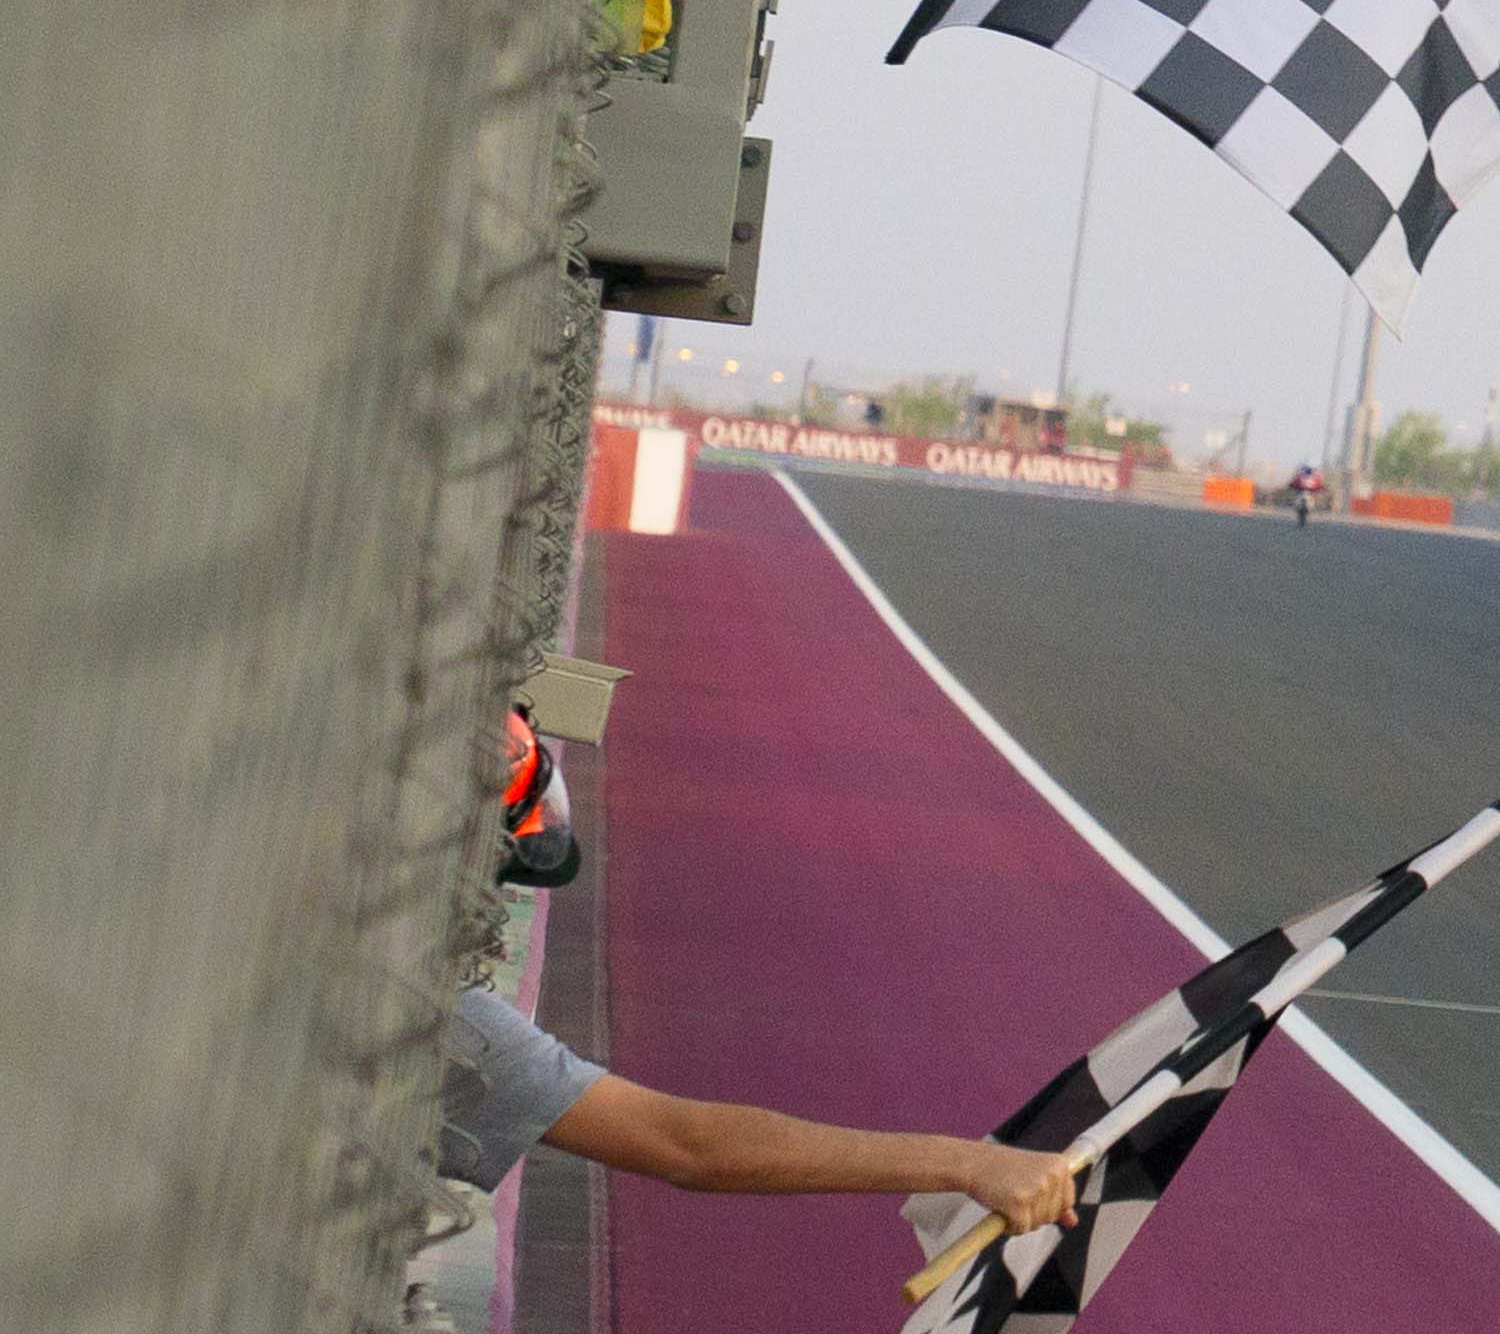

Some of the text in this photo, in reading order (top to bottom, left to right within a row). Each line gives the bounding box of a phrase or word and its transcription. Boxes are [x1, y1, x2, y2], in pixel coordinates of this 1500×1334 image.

[702, 417, 788, 455] QATAR
[791, 428, 898, 466] AIRWAYS
[926, 442, 1118, 490] QATAR AIRWAYS
